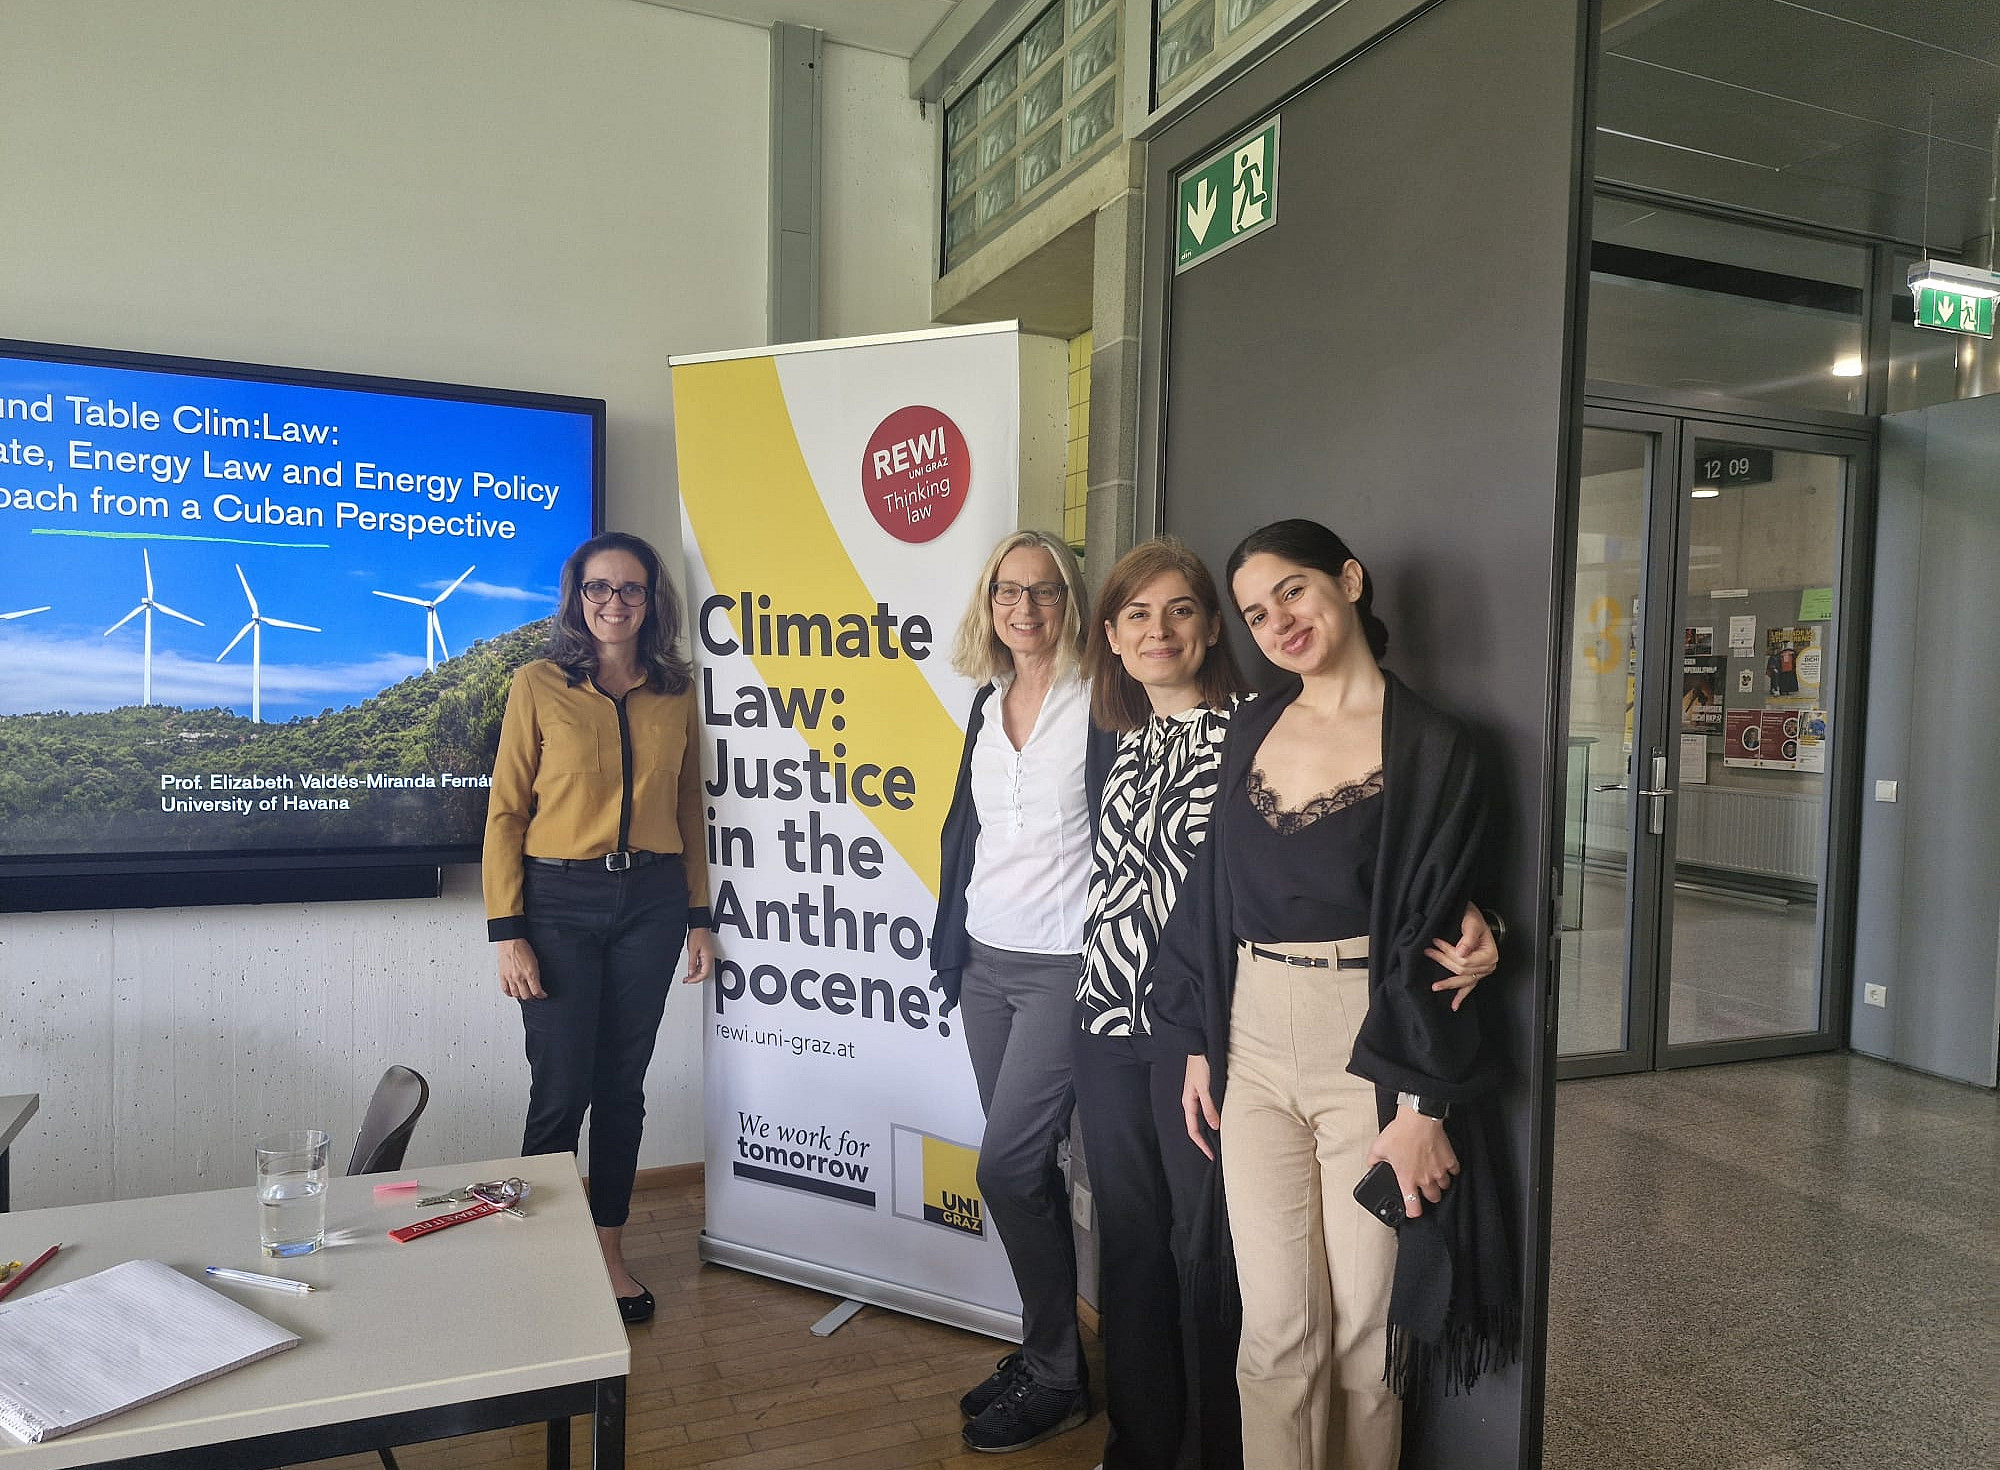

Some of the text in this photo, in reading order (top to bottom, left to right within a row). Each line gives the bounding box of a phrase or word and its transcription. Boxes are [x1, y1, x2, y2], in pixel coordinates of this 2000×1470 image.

[0, 393, 339, 446] nd Table Clim:Law:
[69, 440, 191, 484] Energy
[203, 450, 272, 482] Law
[282, 459, 343, 488] and
[355, 462, 463, 503] Energy
[473, 471, 560, 510] Policy
[873, 426, 945, 480] REWI
[908, 457, 949, 480] UNI GRAZ
[1704, 458, 1749, 479] 12 09
[90, 486, 169, 518] from
[181, 499, 202, 521] a
[213, 494, 324, 527] Cuban
[336, 502, 517, 540] Perspective
[883, 477, 951, 513] Thinking
[906, 504, 932, 525] law
[699, 592, 933, 661] Climate
[1584, 596, 1623, 675] 3
[703, 667, 846, 732] Law:
[161, 774, 203, 790] Prof.
[210, 773, 294, 790] Elizabeth
[299, 773, 437, 790] Valdés-Miranda
[705, 738, 916, 810] Justice
[161, 795, 350, 816] University of Havana
[706, 806, 884, 880] in the
[716, 1023, 856, 1060] rewi.uni-graz.at
[737, 1111, 871, 1158] We work for
[737, 1135, 870, 1184] tomorrow
[942, 1189, 980, 1219] UNI
[943, 1211, 981, 1231] GRAZ
[411, 1223, 432, 1233] FLY
